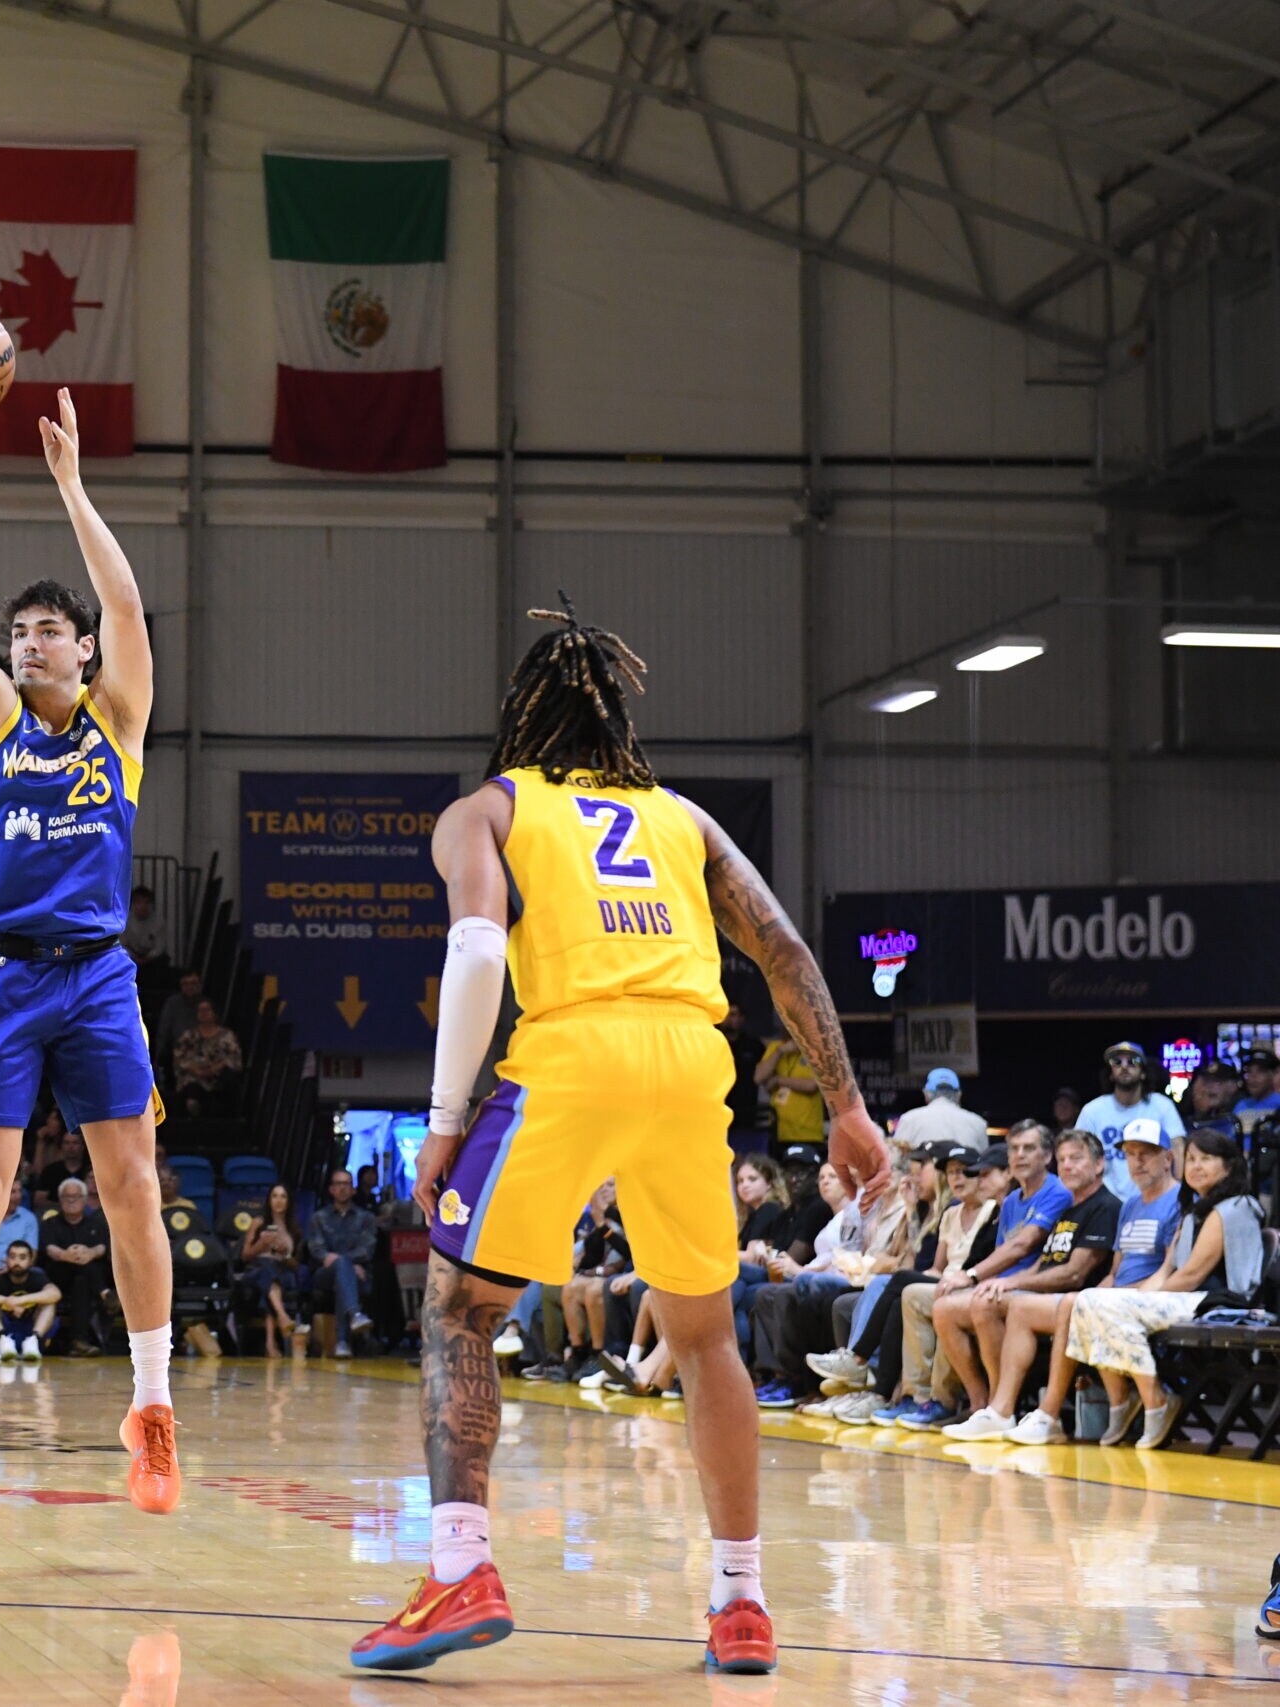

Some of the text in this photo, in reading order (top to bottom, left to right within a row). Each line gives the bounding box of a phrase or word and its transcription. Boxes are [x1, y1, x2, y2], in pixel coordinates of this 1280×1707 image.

[65, 756, 112, 806] 25
[48, 813, 77, 827] KAISER
[247, 811, 326, 834] TEAM
[362, 812, 437, 836] STOR
[573, 796, 657, 889] 2
[266, 883, 435, 898] SCORE BIG
[291, 904, 410, 918] WITH OUR
[598, 899, 673, 935] DAVIS
[253, 923, 301, 938] SEA
[306, 923, 373, 938] DUBS
[1003, 895, 1195, 962] Modelo
[860, 930, 918, 959] Modelo
